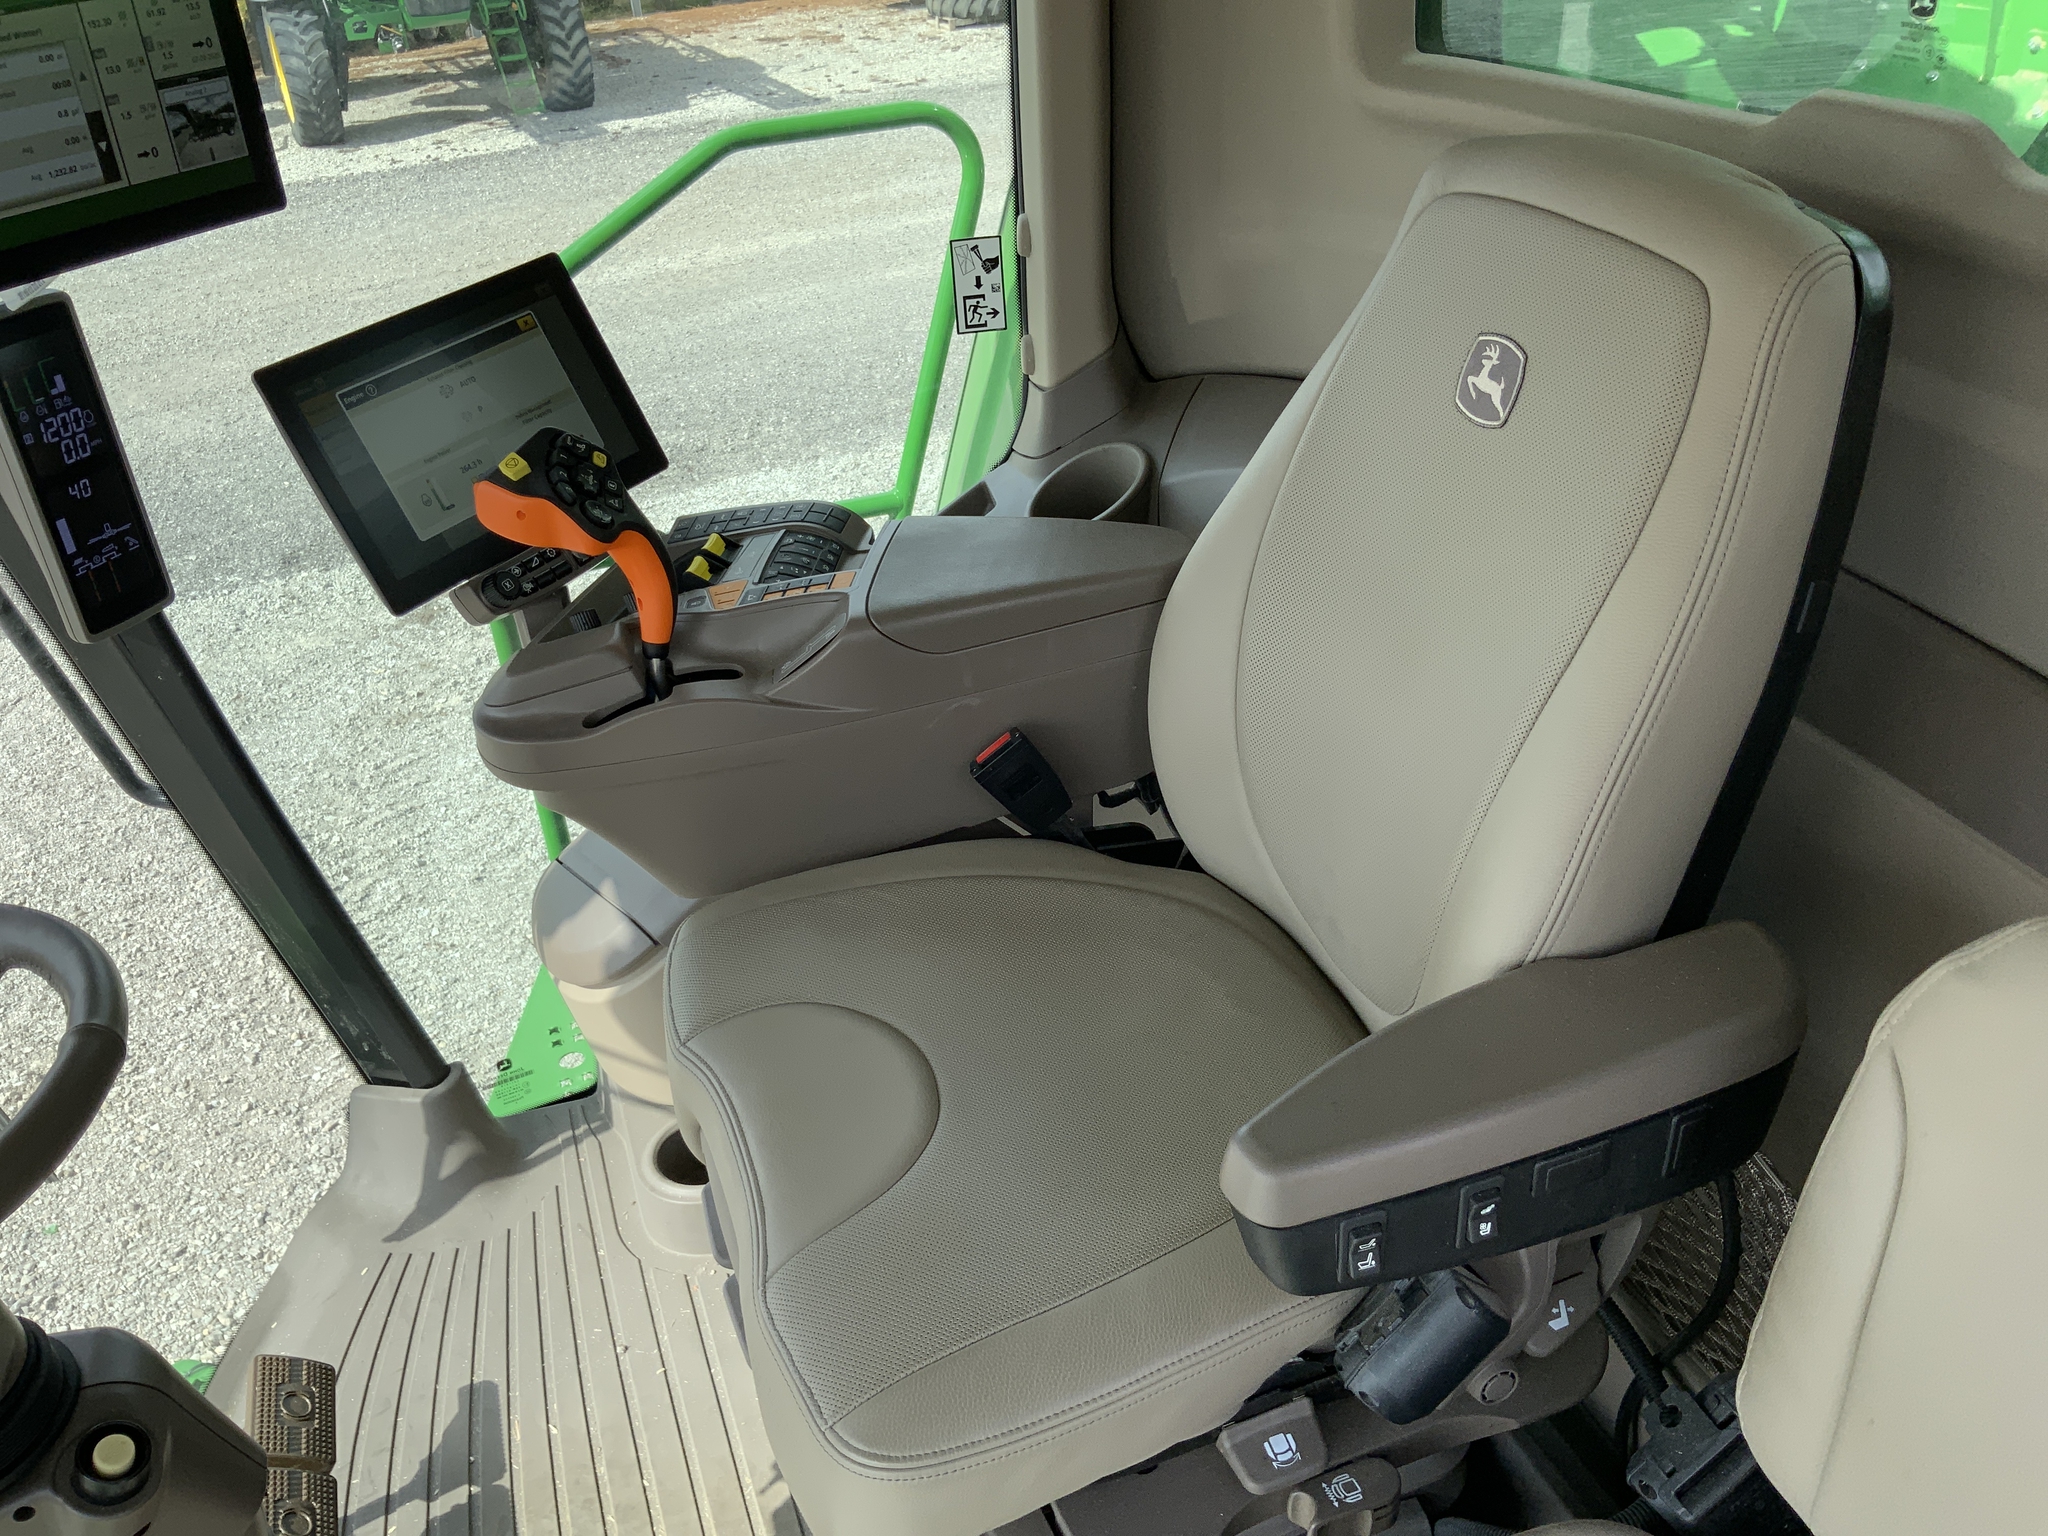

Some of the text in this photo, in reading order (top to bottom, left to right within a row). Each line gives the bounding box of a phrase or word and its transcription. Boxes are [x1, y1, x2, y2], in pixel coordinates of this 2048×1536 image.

[459, 376, 477, 388] AUTO
[344, 392, 365, 405] Engine
[40, 407, 85, 443] 1200
[61, 432, 91, 465] 0.0
[68, 478, 92, 499] 40
